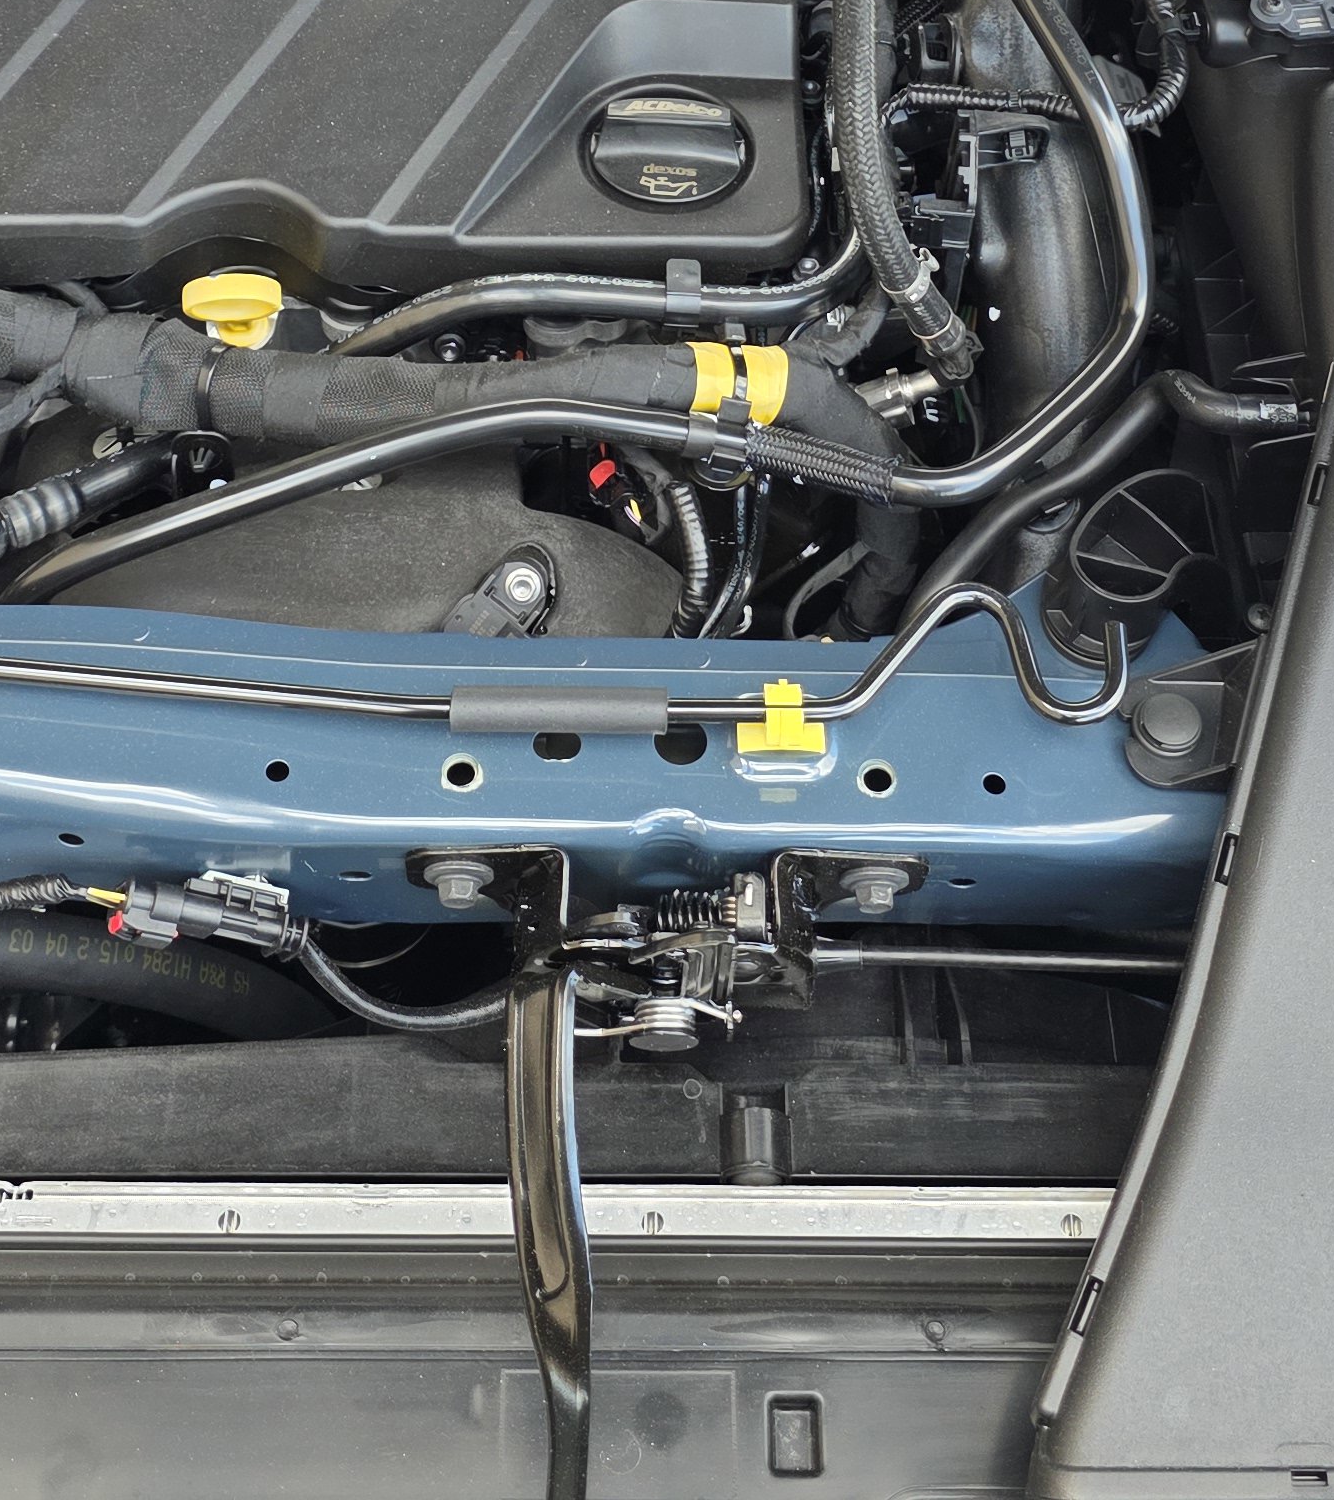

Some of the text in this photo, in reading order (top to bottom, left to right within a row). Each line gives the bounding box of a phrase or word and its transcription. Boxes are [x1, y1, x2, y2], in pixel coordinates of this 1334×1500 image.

[625, 100, 723, 117] ACDelco
[643, 163, 698, 177] dexos
[8, 932, 34, 953] 03
[45, 934, 66, 955] 04
